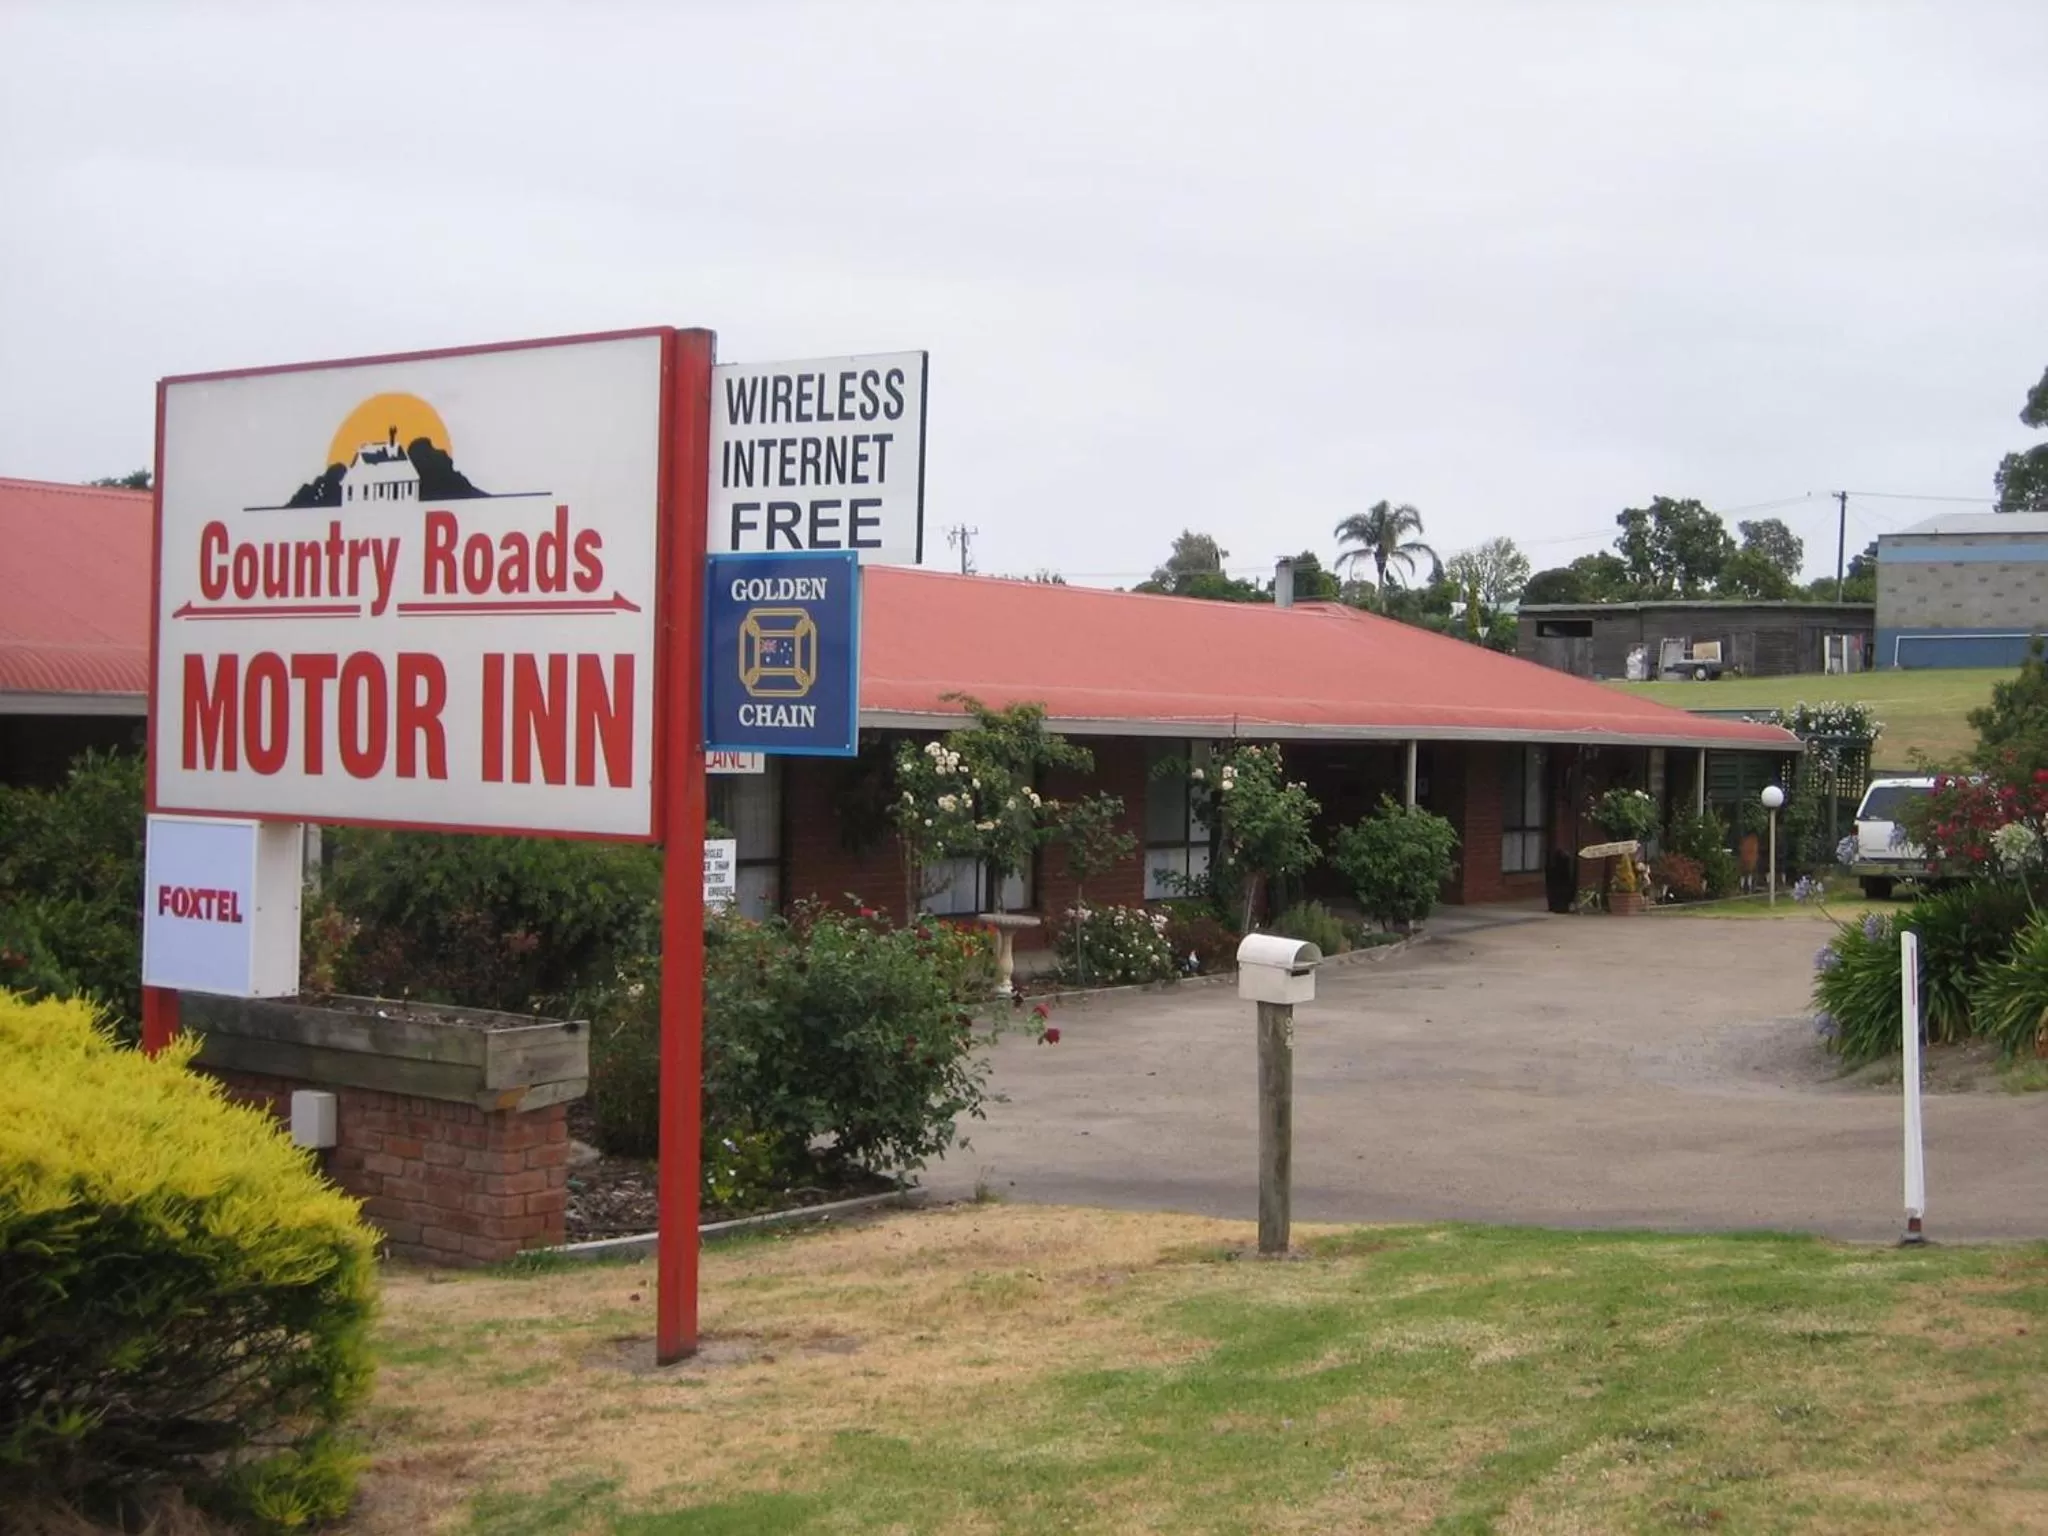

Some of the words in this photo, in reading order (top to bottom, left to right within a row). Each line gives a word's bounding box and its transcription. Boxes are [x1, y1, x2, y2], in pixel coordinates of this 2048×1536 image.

[725, 368, 905, 426] WIRELESS
[722, 433, 894, 489] INTERNET
[730, 498, 883, 551] FREE
[200, 519, 400, 617] Country
[423, 505, 604, 596] Roads
[731, 577, 828, 602] GOLDEN
[182, 650, 448, 781] MOTOR
[482, 653, 635, 789] INN
[738, 703, 817, 728] CHAIN
[158, 885, 243, 924] FOXTEL
